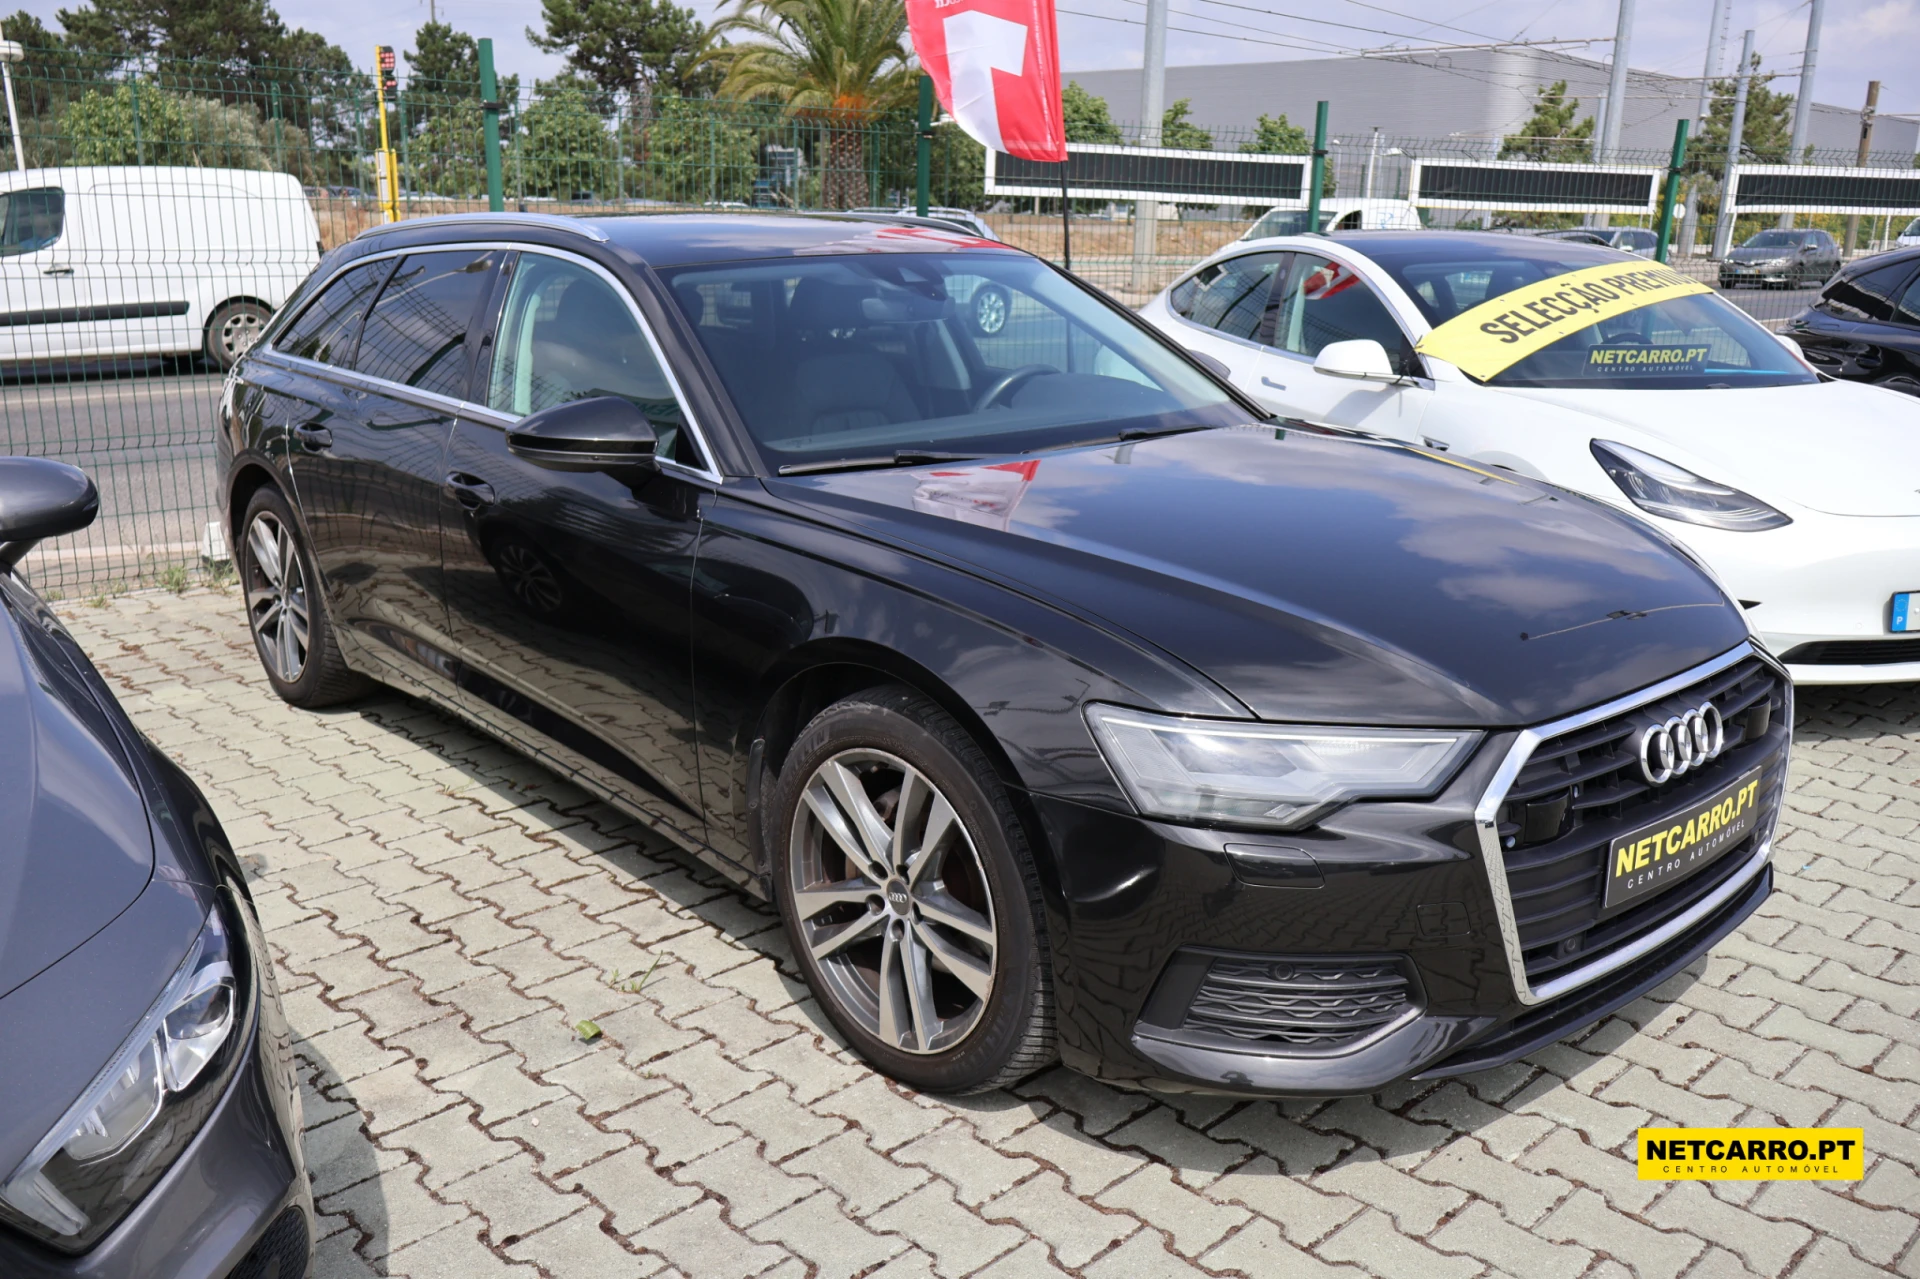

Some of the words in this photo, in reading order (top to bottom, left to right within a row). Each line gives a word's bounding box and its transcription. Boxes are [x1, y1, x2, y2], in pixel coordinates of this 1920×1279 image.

[1480, 282, 1620, 344] SELECÇÃO
[1590, 349, 1707, 364] NETCARRO.PT
[1896, 616, 1903, 625] P
[1616, 779, 1758, 877] NETCARRO.PT
[1627, 858, 1681, 889] CENTRO
[1689, 819, 1745, 862] AUTOMÓVEL
